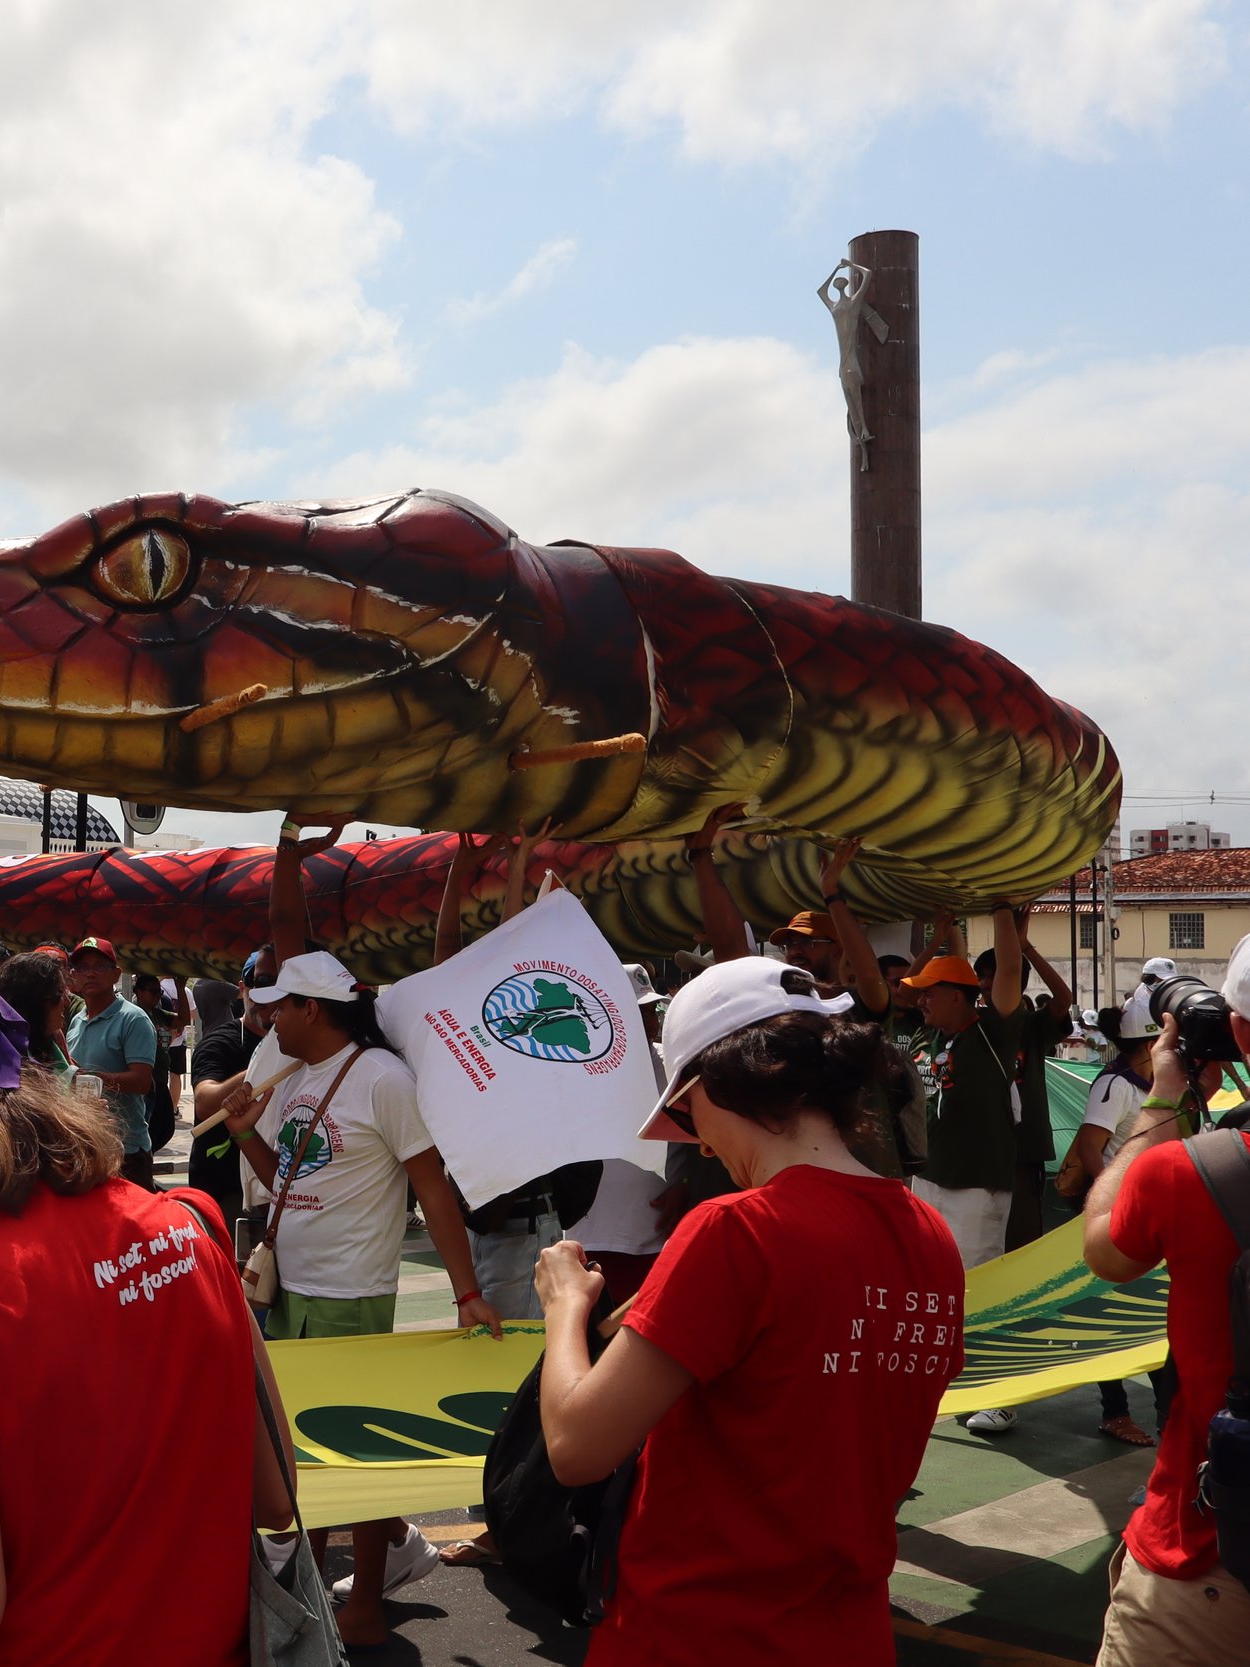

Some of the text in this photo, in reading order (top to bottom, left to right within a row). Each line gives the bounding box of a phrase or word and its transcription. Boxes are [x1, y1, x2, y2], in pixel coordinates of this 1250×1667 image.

[513, 960, 578, 978] MOVIMENTO
[577, 974, 597, 990] DOS
[593, 988, 627, 1036] ATINGIDOS
[438, 1008, 496, 1081] ÁGUA E ENERGIA
[470, 1025, 492, 1048] Brasil
[424, 1012, 487, 1093] NÃO SÃO MERCADORIAS
[93, 1260, 118, 1289] Ni
[149, 1231, 169, 1255] ni
[118, 1280, 139, 1306] ni
[905, 1291, 956, 1316] SET
[893, 1321, 956, 1346] FRE
[822, 1351, 862, 1374] NI
